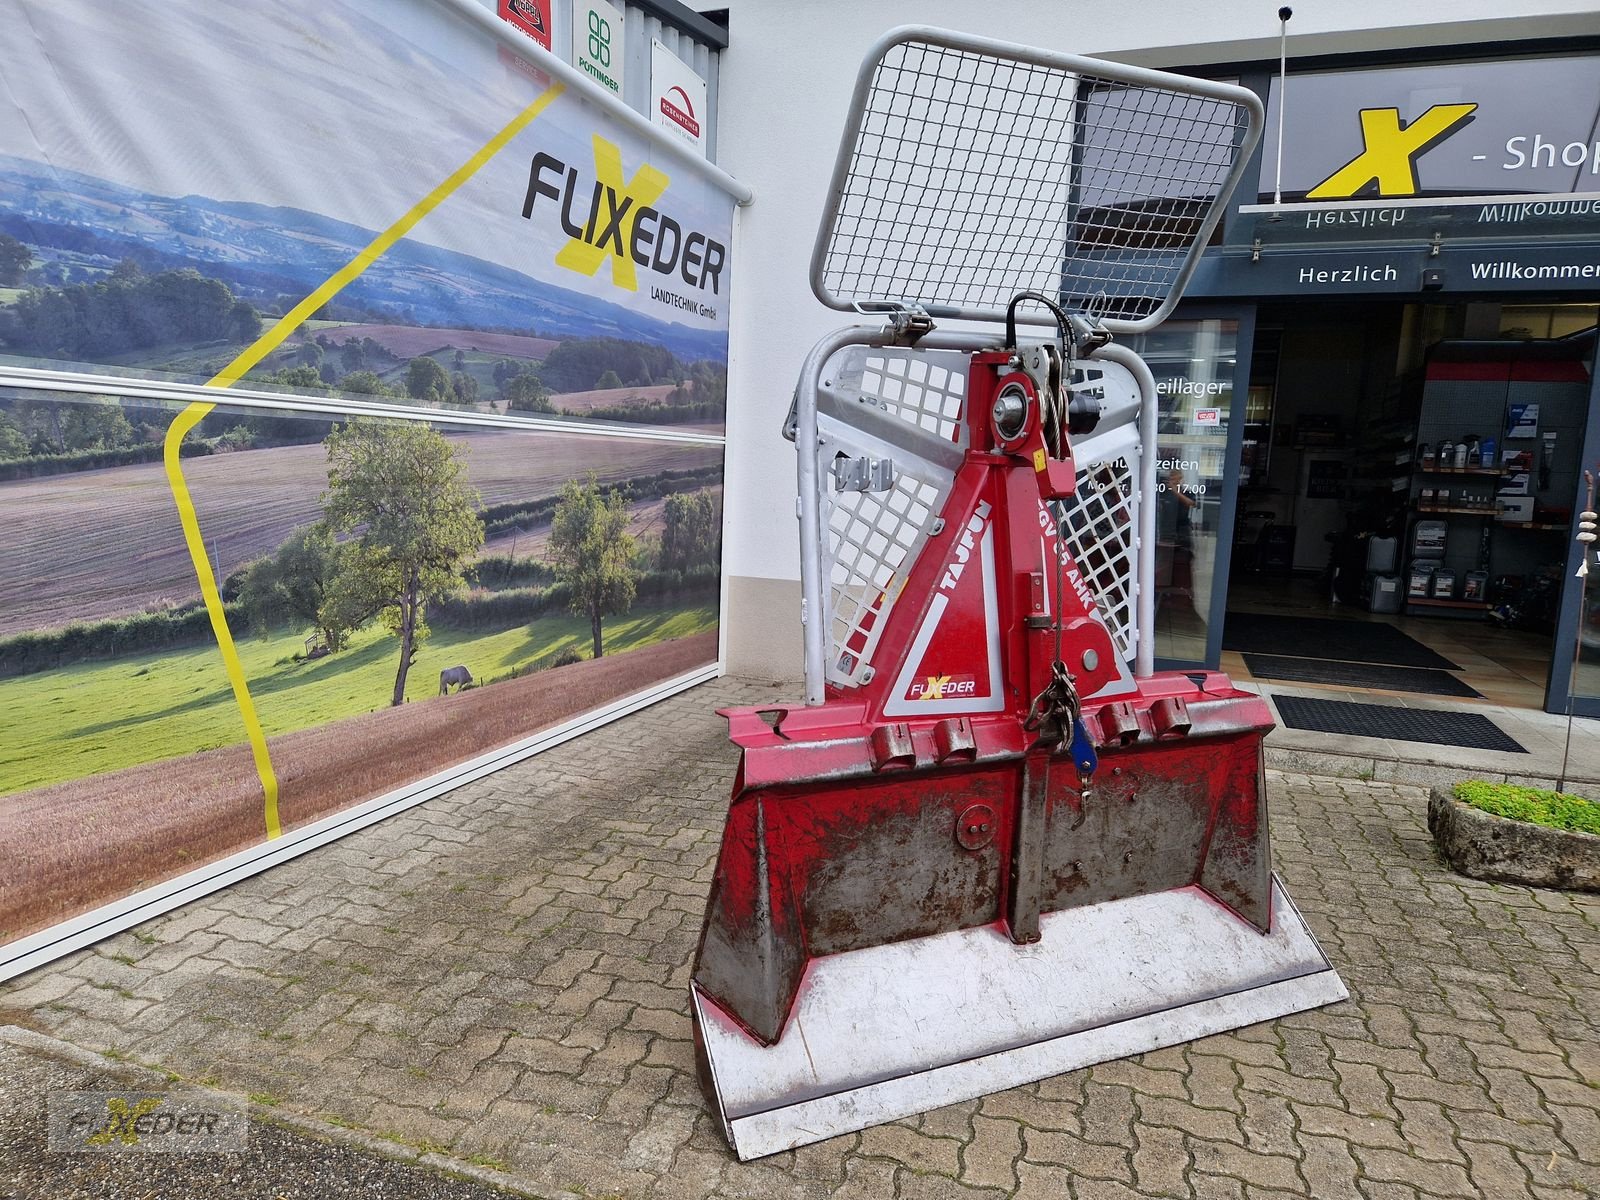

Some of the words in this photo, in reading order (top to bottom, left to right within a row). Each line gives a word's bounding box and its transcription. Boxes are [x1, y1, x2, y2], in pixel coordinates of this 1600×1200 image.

[522, 146, 725, 295] FLIXEDER
[1299, 265, 1398, 283] Herzlich
[651, 286, 698, 314] LANDTECHNIK
[1156, 378, 1226, 398] eillager
[1176, 484, 1206, 494] 17:00
[940, 499, 993, 590] TAJFUN
[1066, 568, 1094, 610] AHK
